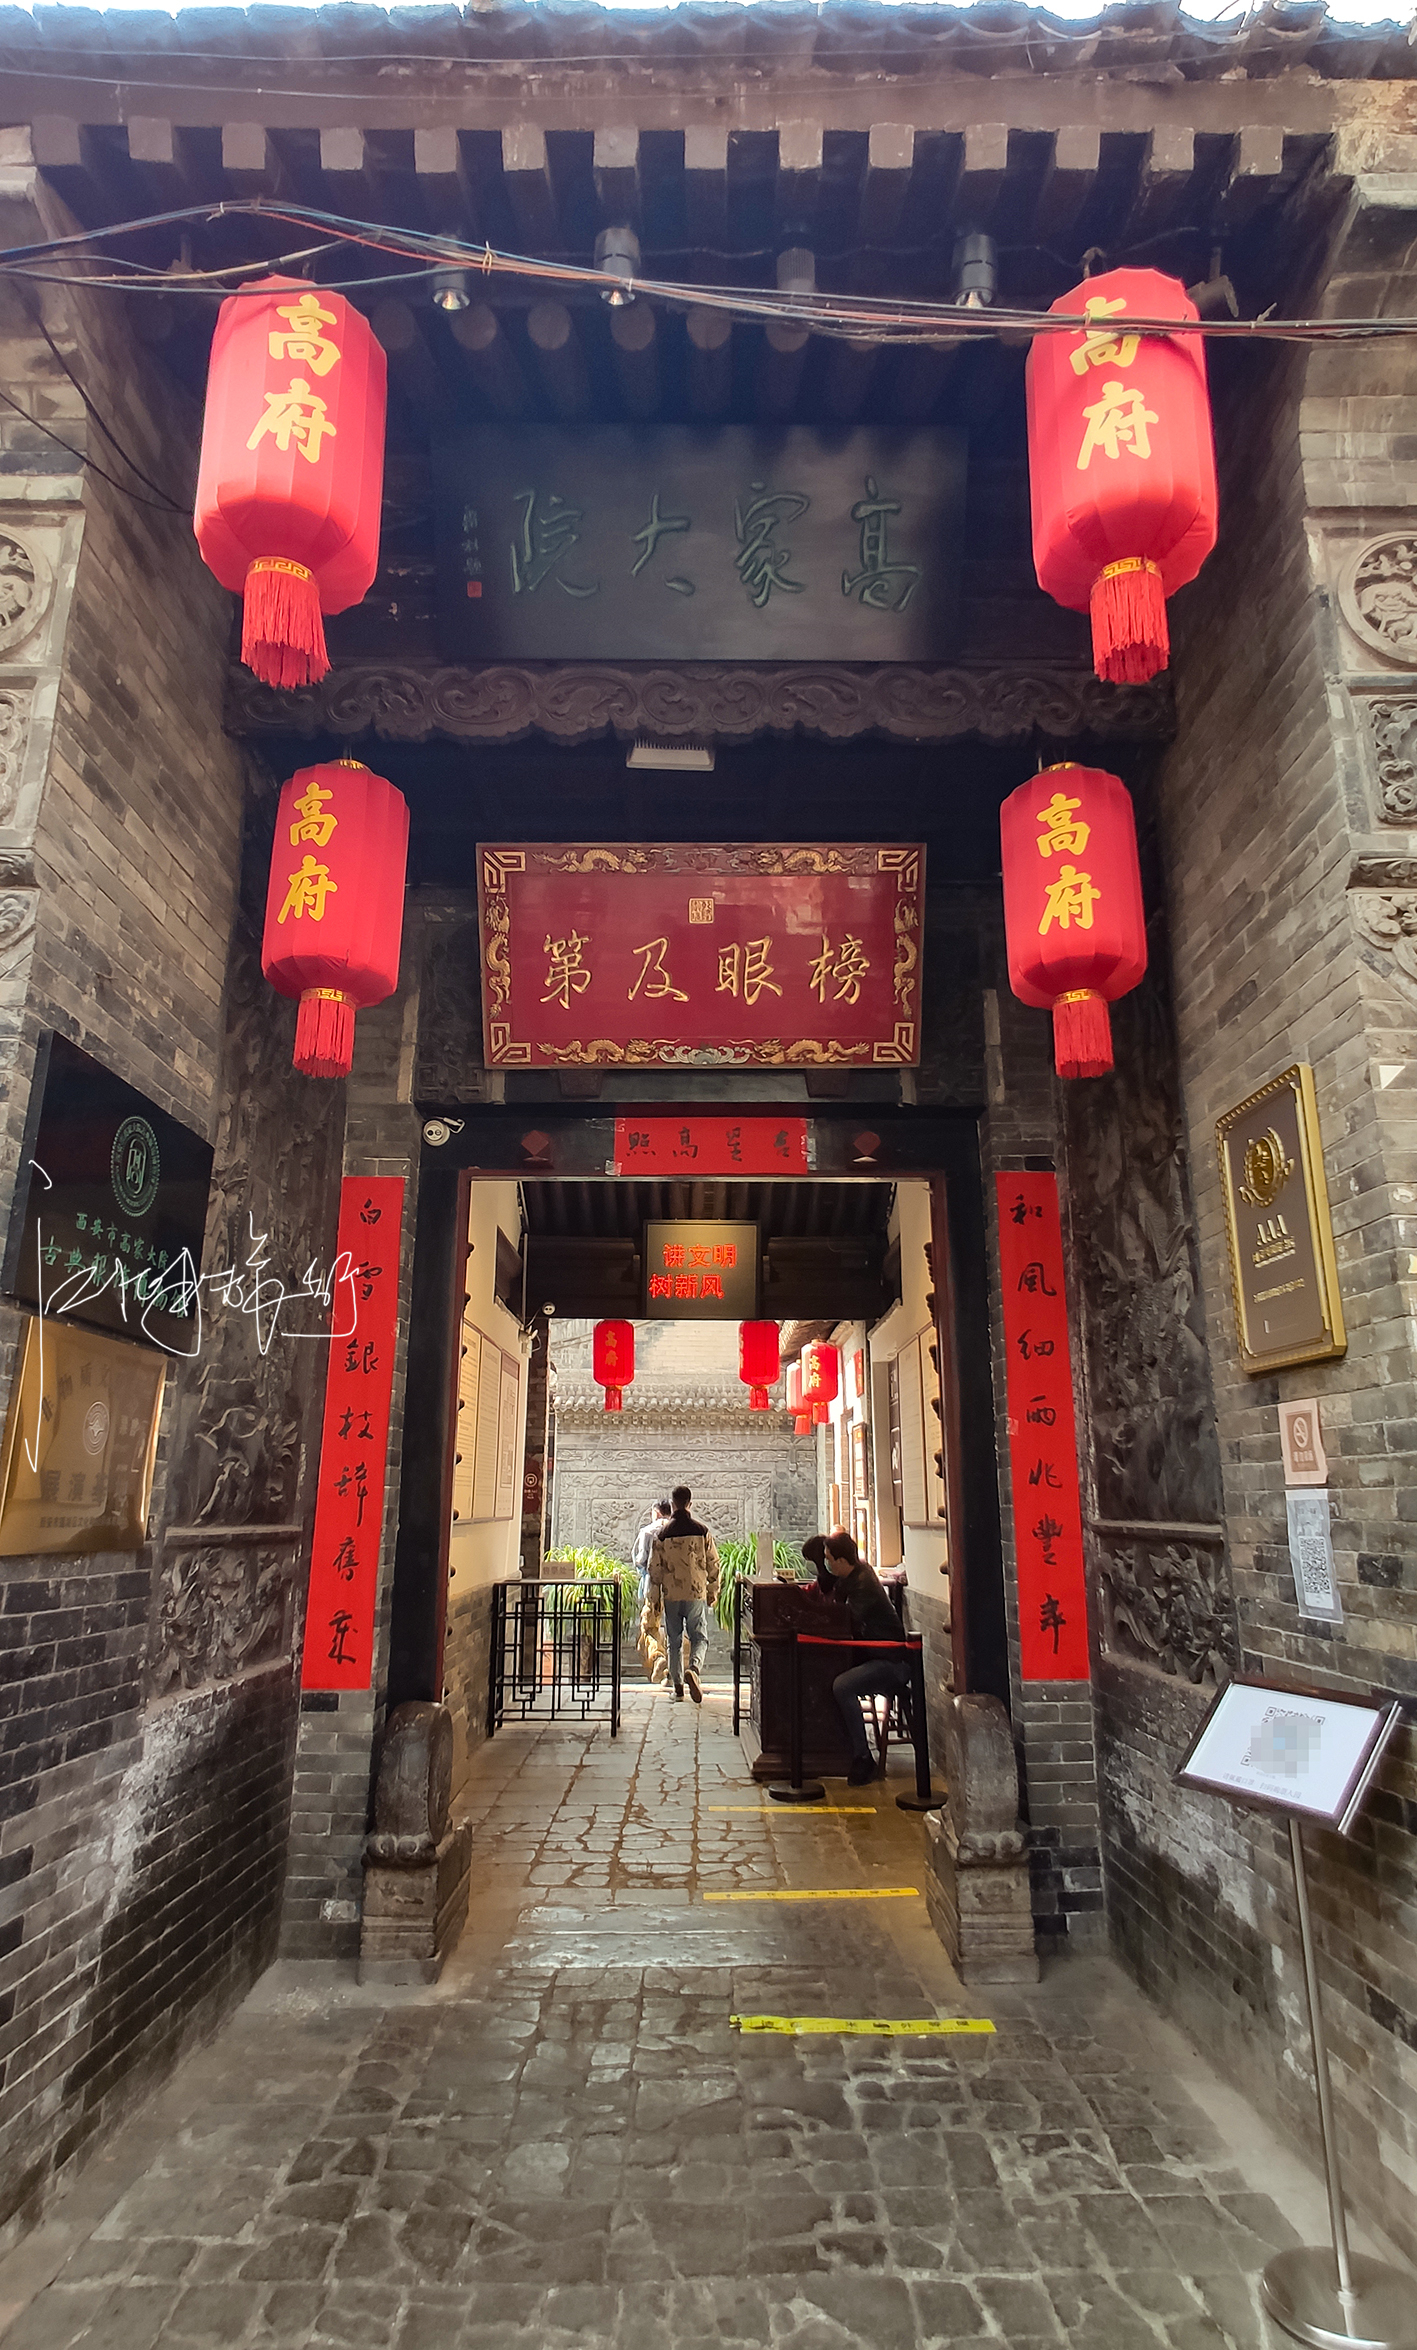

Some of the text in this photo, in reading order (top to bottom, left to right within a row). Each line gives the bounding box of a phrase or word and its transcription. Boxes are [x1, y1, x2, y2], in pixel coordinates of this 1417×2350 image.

[247, 294, 341, 464] 高府
[1070, 296, 1159, 470] 高府
[277, 781, 339, 925] 高府
[1035, 792, 1101, 936] 高府
[648, 1273, 725, 1300] 树新风
[662, 1242, 738, 1269] 讲文明
